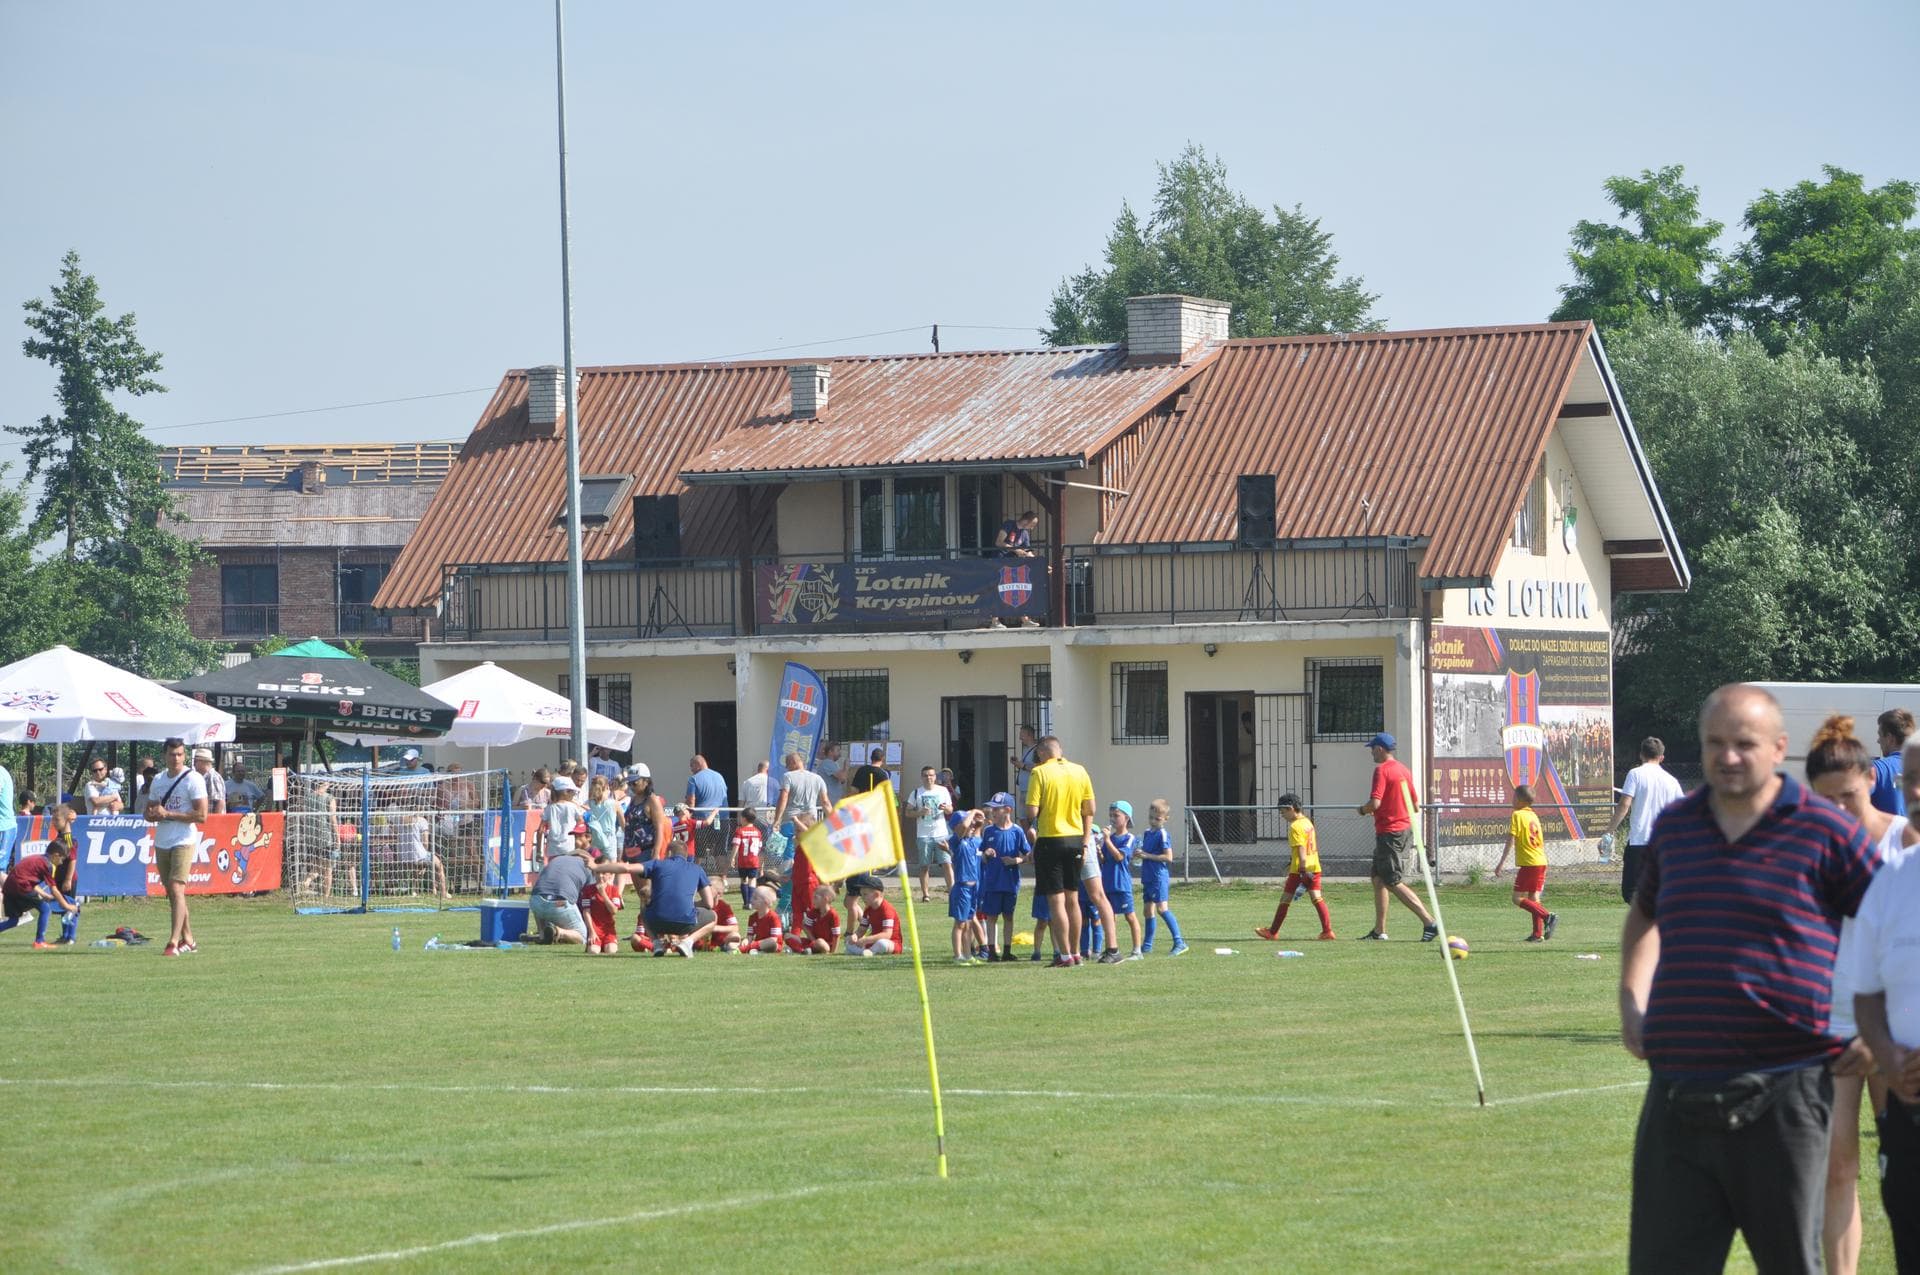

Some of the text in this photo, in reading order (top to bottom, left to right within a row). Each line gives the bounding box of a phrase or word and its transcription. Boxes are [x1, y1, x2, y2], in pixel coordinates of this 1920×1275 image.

[854, 573, 950, 591] Lotnik
[854, 592, 980, 610] Kryspinów
[1468, 579, 1589, 619] KS LOTNIK
[257, 683, 366, 696] BECK'S
[216, 695, 288, 710] BECK'S
[361, 704, 433, 722] BECK'S
[88, 815, 134, 828] szkółka
[86, 831, 216, 865] Lotk
[742, 837, 760, 857] 14
